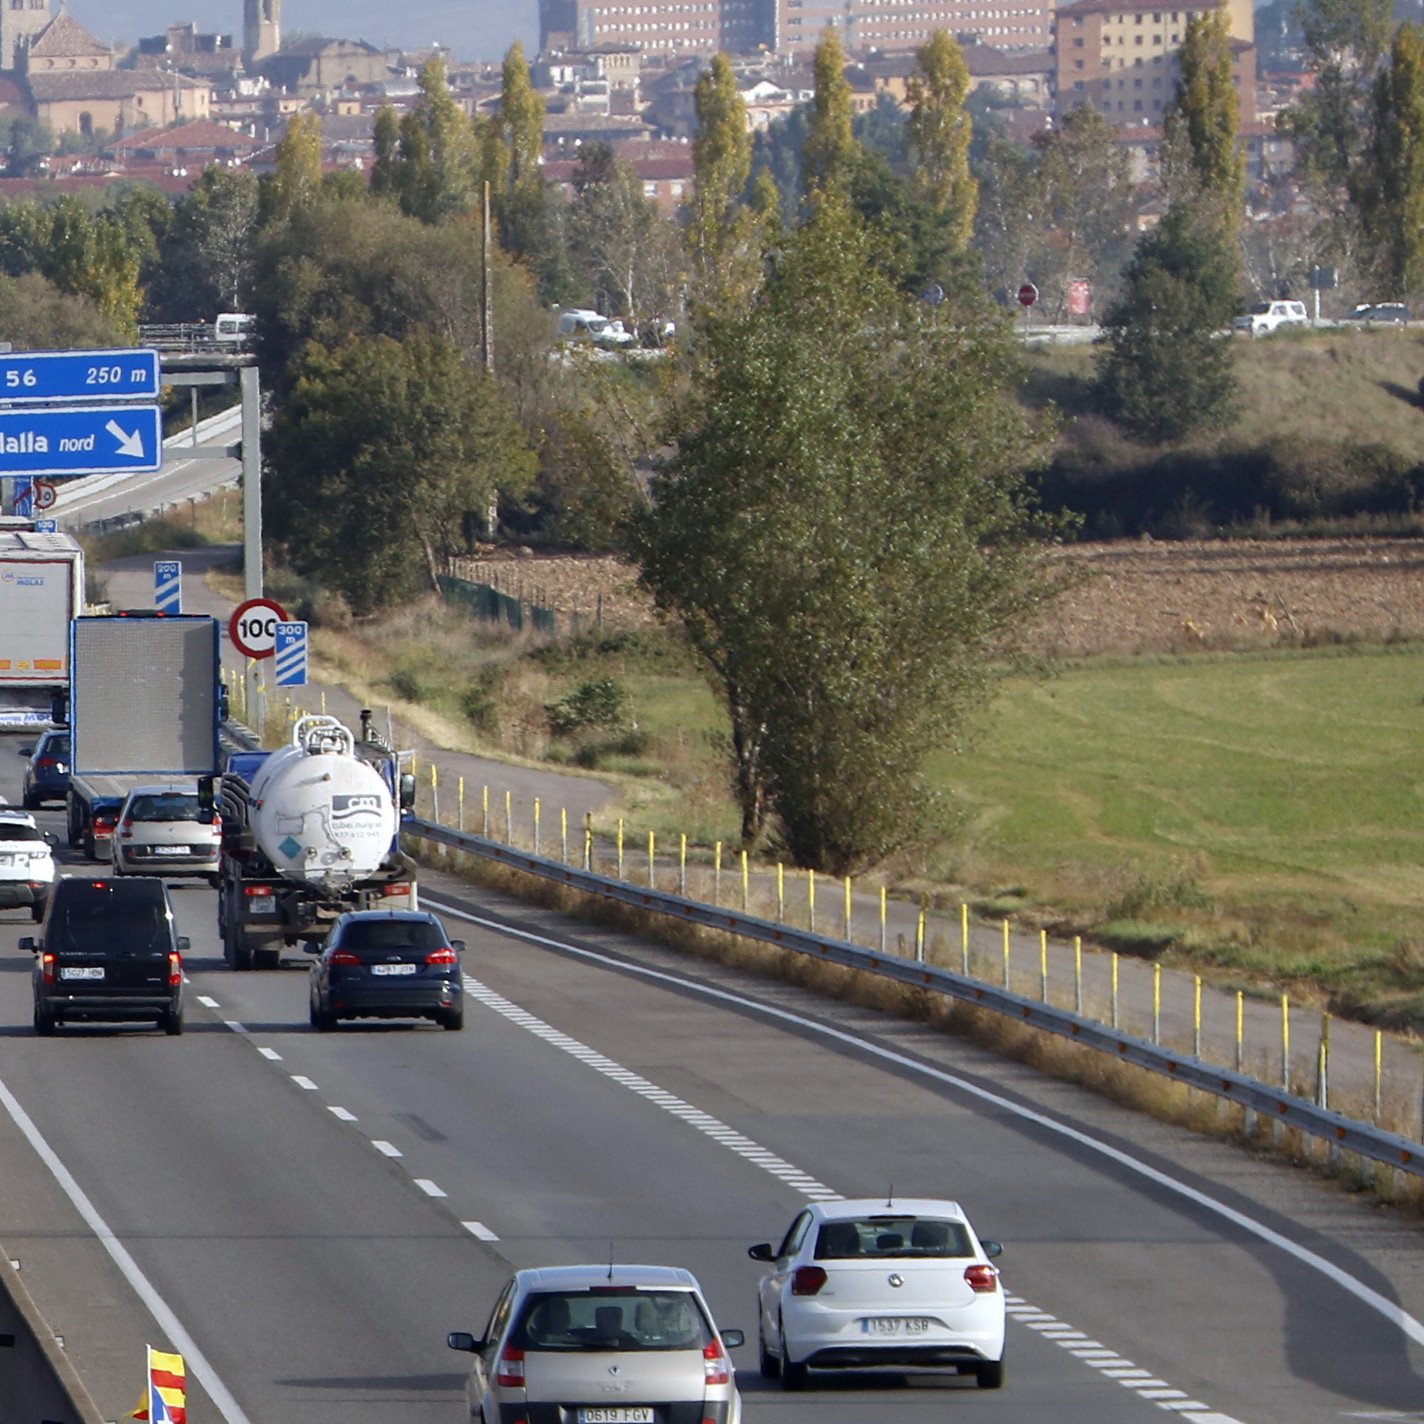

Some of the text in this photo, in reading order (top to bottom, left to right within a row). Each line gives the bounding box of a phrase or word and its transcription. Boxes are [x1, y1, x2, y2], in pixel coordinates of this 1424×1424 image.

[6, 366, 147, 387] 56 250 m
[59, 434, 95, 452] nord
[239, 618, 278, 638] 100
[278, 625, 302, 635] 300
[872, 1318, 900, 1332] 1537
[586, 1409, 650, 1422] 0619 FGV
